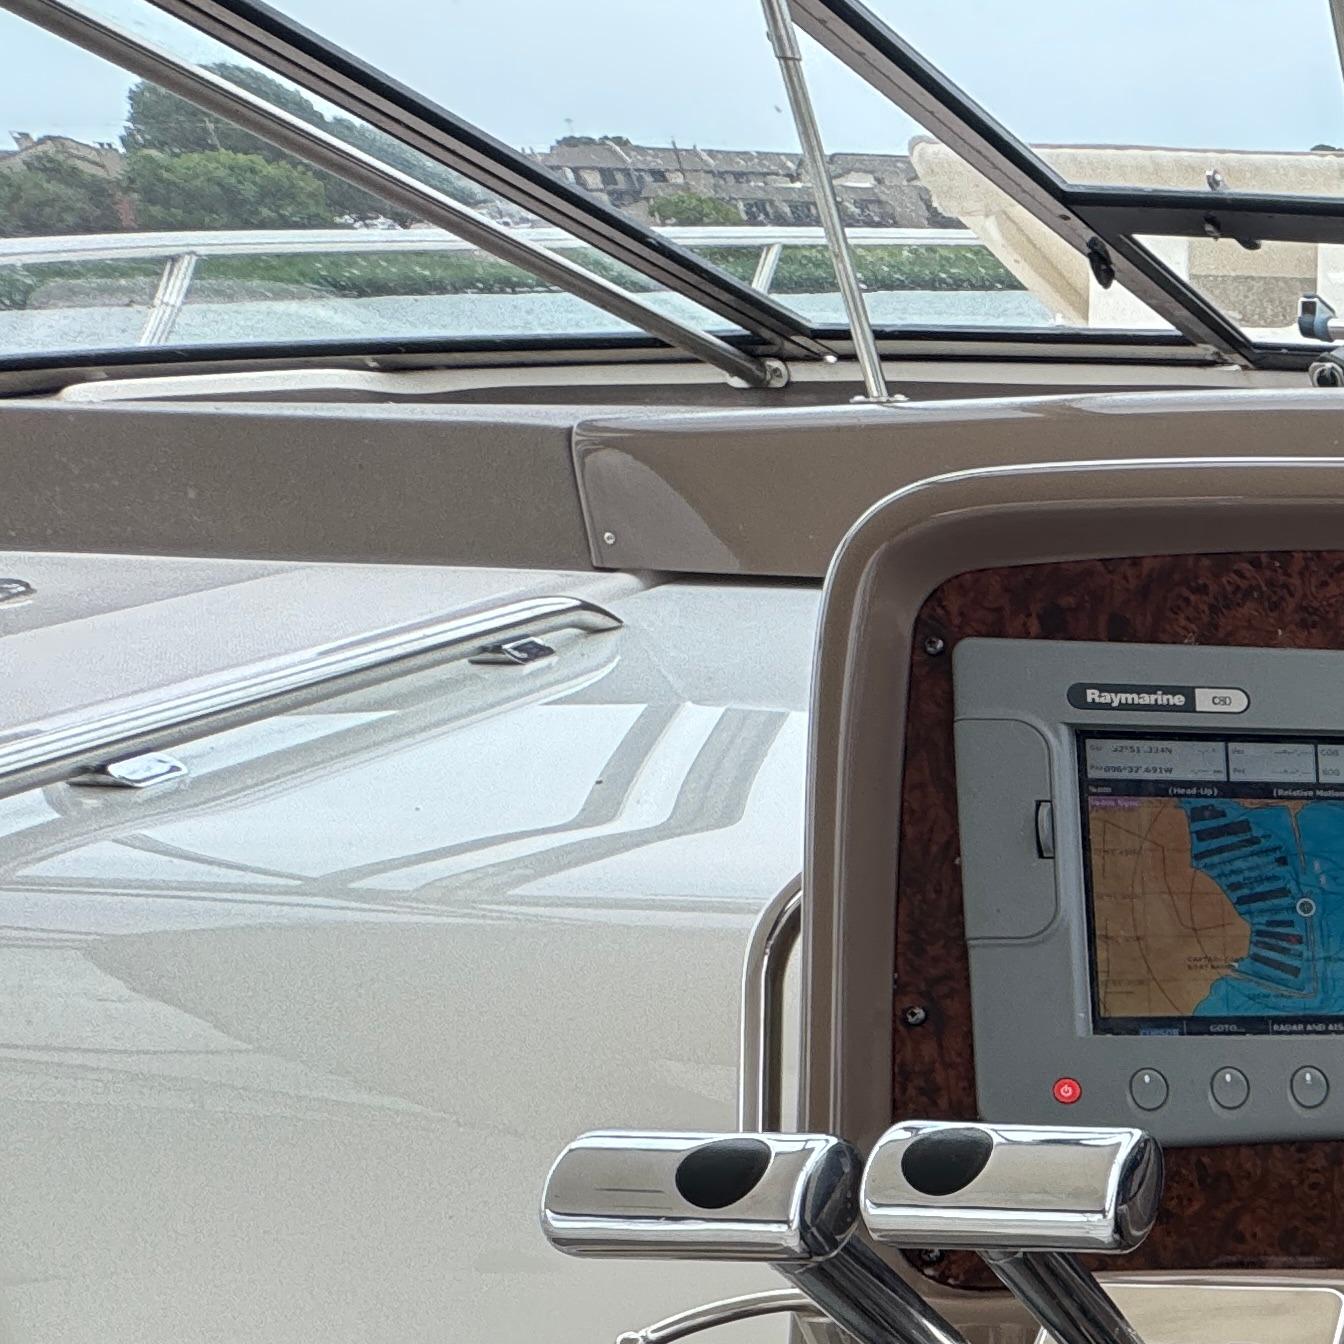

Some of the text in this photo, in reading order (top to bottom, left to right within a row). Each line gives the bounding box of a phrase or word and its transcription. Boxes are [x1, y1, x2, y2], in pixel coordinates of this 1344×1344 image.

[1085, 688, 1186, 707] Raymarine
[1273, 1023, 1304, 1032] RADAR
[1306, 1023, 1326, 1032] AND
